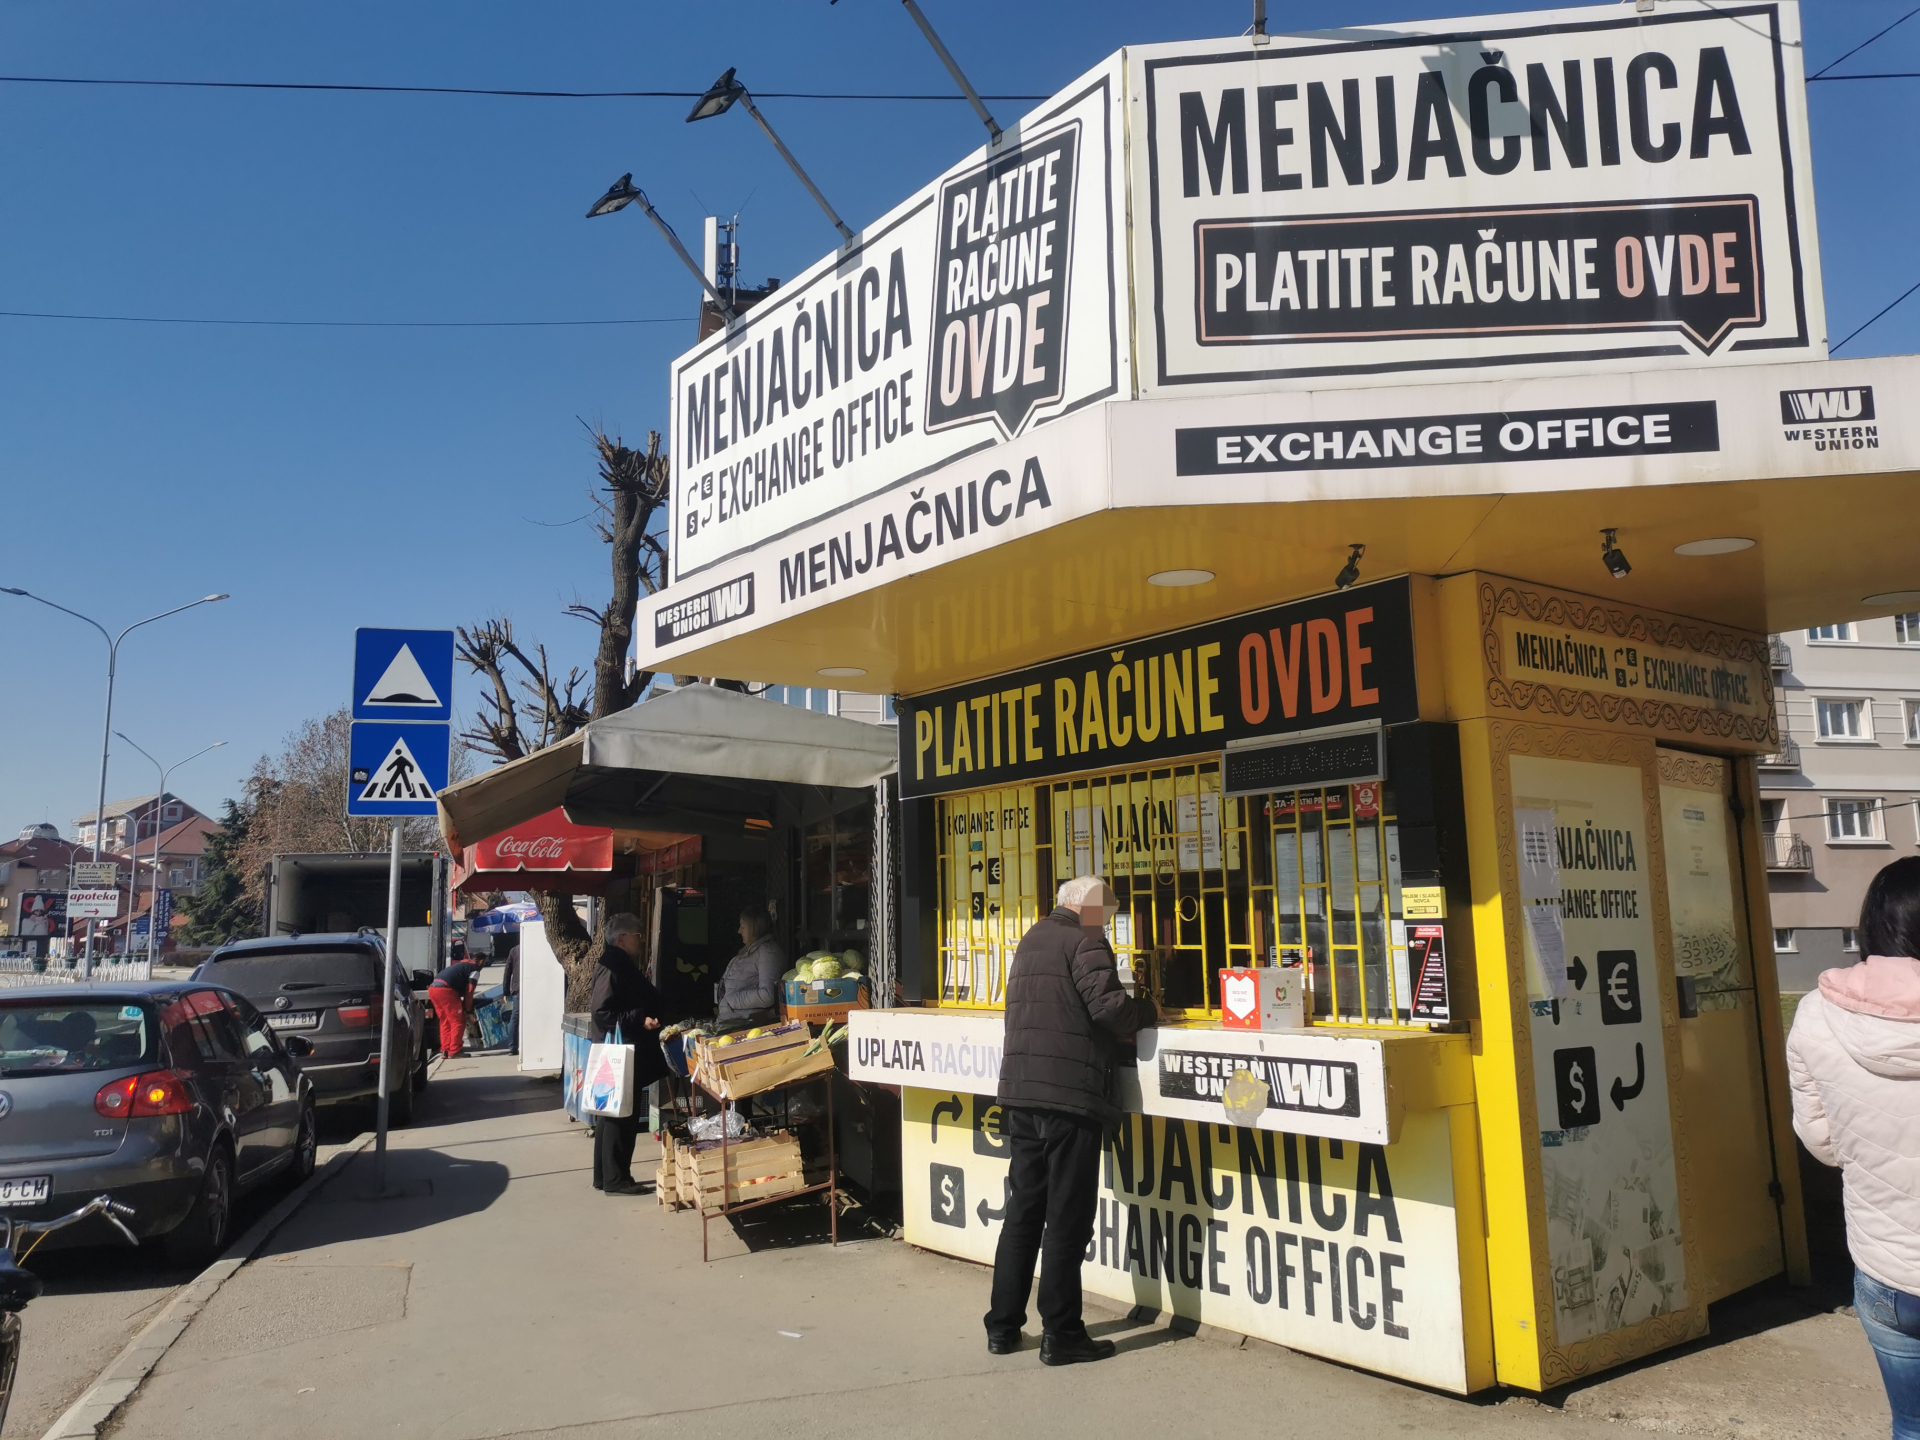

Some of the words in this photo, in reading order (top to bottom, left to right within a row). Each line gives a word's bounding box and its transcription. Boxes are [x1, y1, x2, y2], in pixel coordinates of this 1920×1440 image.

[1180, 46, 1752, 199] MENJAČNICA
[950, 149, 1062, 250] PLATITE
[947, 219, 1054, 314] RAČUNE
[1215, 246, 1395, 313] PLATITE
[1412, 229, 1600, 306] RAČUNE
[1615, 232, 1741, 298] OVDE
[687, 246, 912, 470] MENJAČNICA
[940, 290, 1051, 407] OVDE
[1797, 390, 1862, 419] WU
[718, 416, 825, 523] EXCHANGE
[832, 369, 913, 467] OFFICE
[1216, 415, 1483, 464] EXCHANGE
[1498, 414, 1672, 452] OFFICE
[1784, 426, 1878, 441] WESTERN
[1815, 438, 1879, 451] UNION
[779, 456, 1051, 602] MENJAČNICA
[657, 594, 709, 628] WESTERN
[672, 610, 710, 637] UNION
[715, 579, 749, 621] WU
[915, 683, 1043, 780] PLATITE
[1054, 642, 1225, 757] RAČUNE
[1238, 606, 1380, 725] OVDE
[1516, 631, 1609, 680] MENJAČNICA
[1643, 656, 1709, 698] EXCHANGE
[1710, 668, 1751, 706] OFFICE
[1232, 745, 1374, 783] MENJAČNICA
[1265, 799, 1287, 809] ATA
[1290, 797, 1312, 807] PATNI
[1313, 794, 1340, 805] PRMET
[495, 835, 567, 858] Coca-Cola
[1555, 820, 1637, 872] NJAČNICA
[69, 892, 117, 902] apoteka
[1600, 889, 1639, 919] OFFICE
[857, 1037, 925, 1072] UPLATA
[931, 1035, 1002, 1079] RAČUN
[1278, 1062, 1346, 1110] WU
[1245, 1225, 1410, 1341] OFFICE
